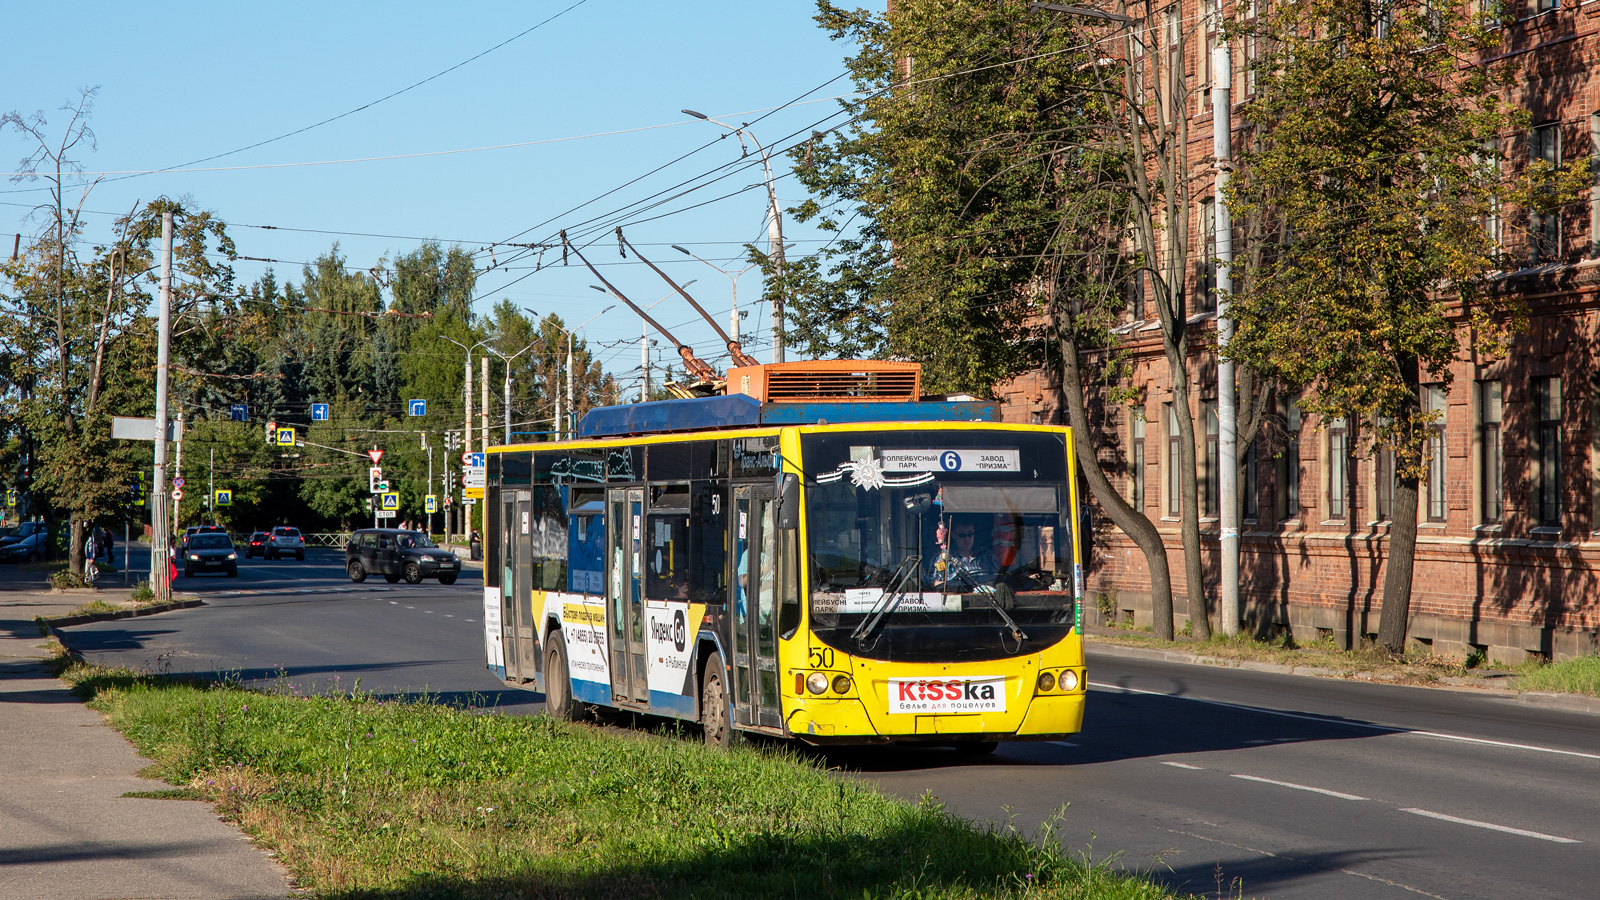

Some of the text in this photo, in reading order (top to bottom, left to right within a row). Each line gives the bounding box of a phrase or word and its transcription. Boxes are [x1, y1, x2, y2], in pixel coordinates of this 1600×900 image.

[741, 450, 775, 473] Транс-Альф
[945, 453, 957, 470] 6
[712, 494, 720, 515] 50
[651, 616, 673, 644] Яндекс
[809, 647, 834, 668] 50
[900, 702, 927, 710] белье
